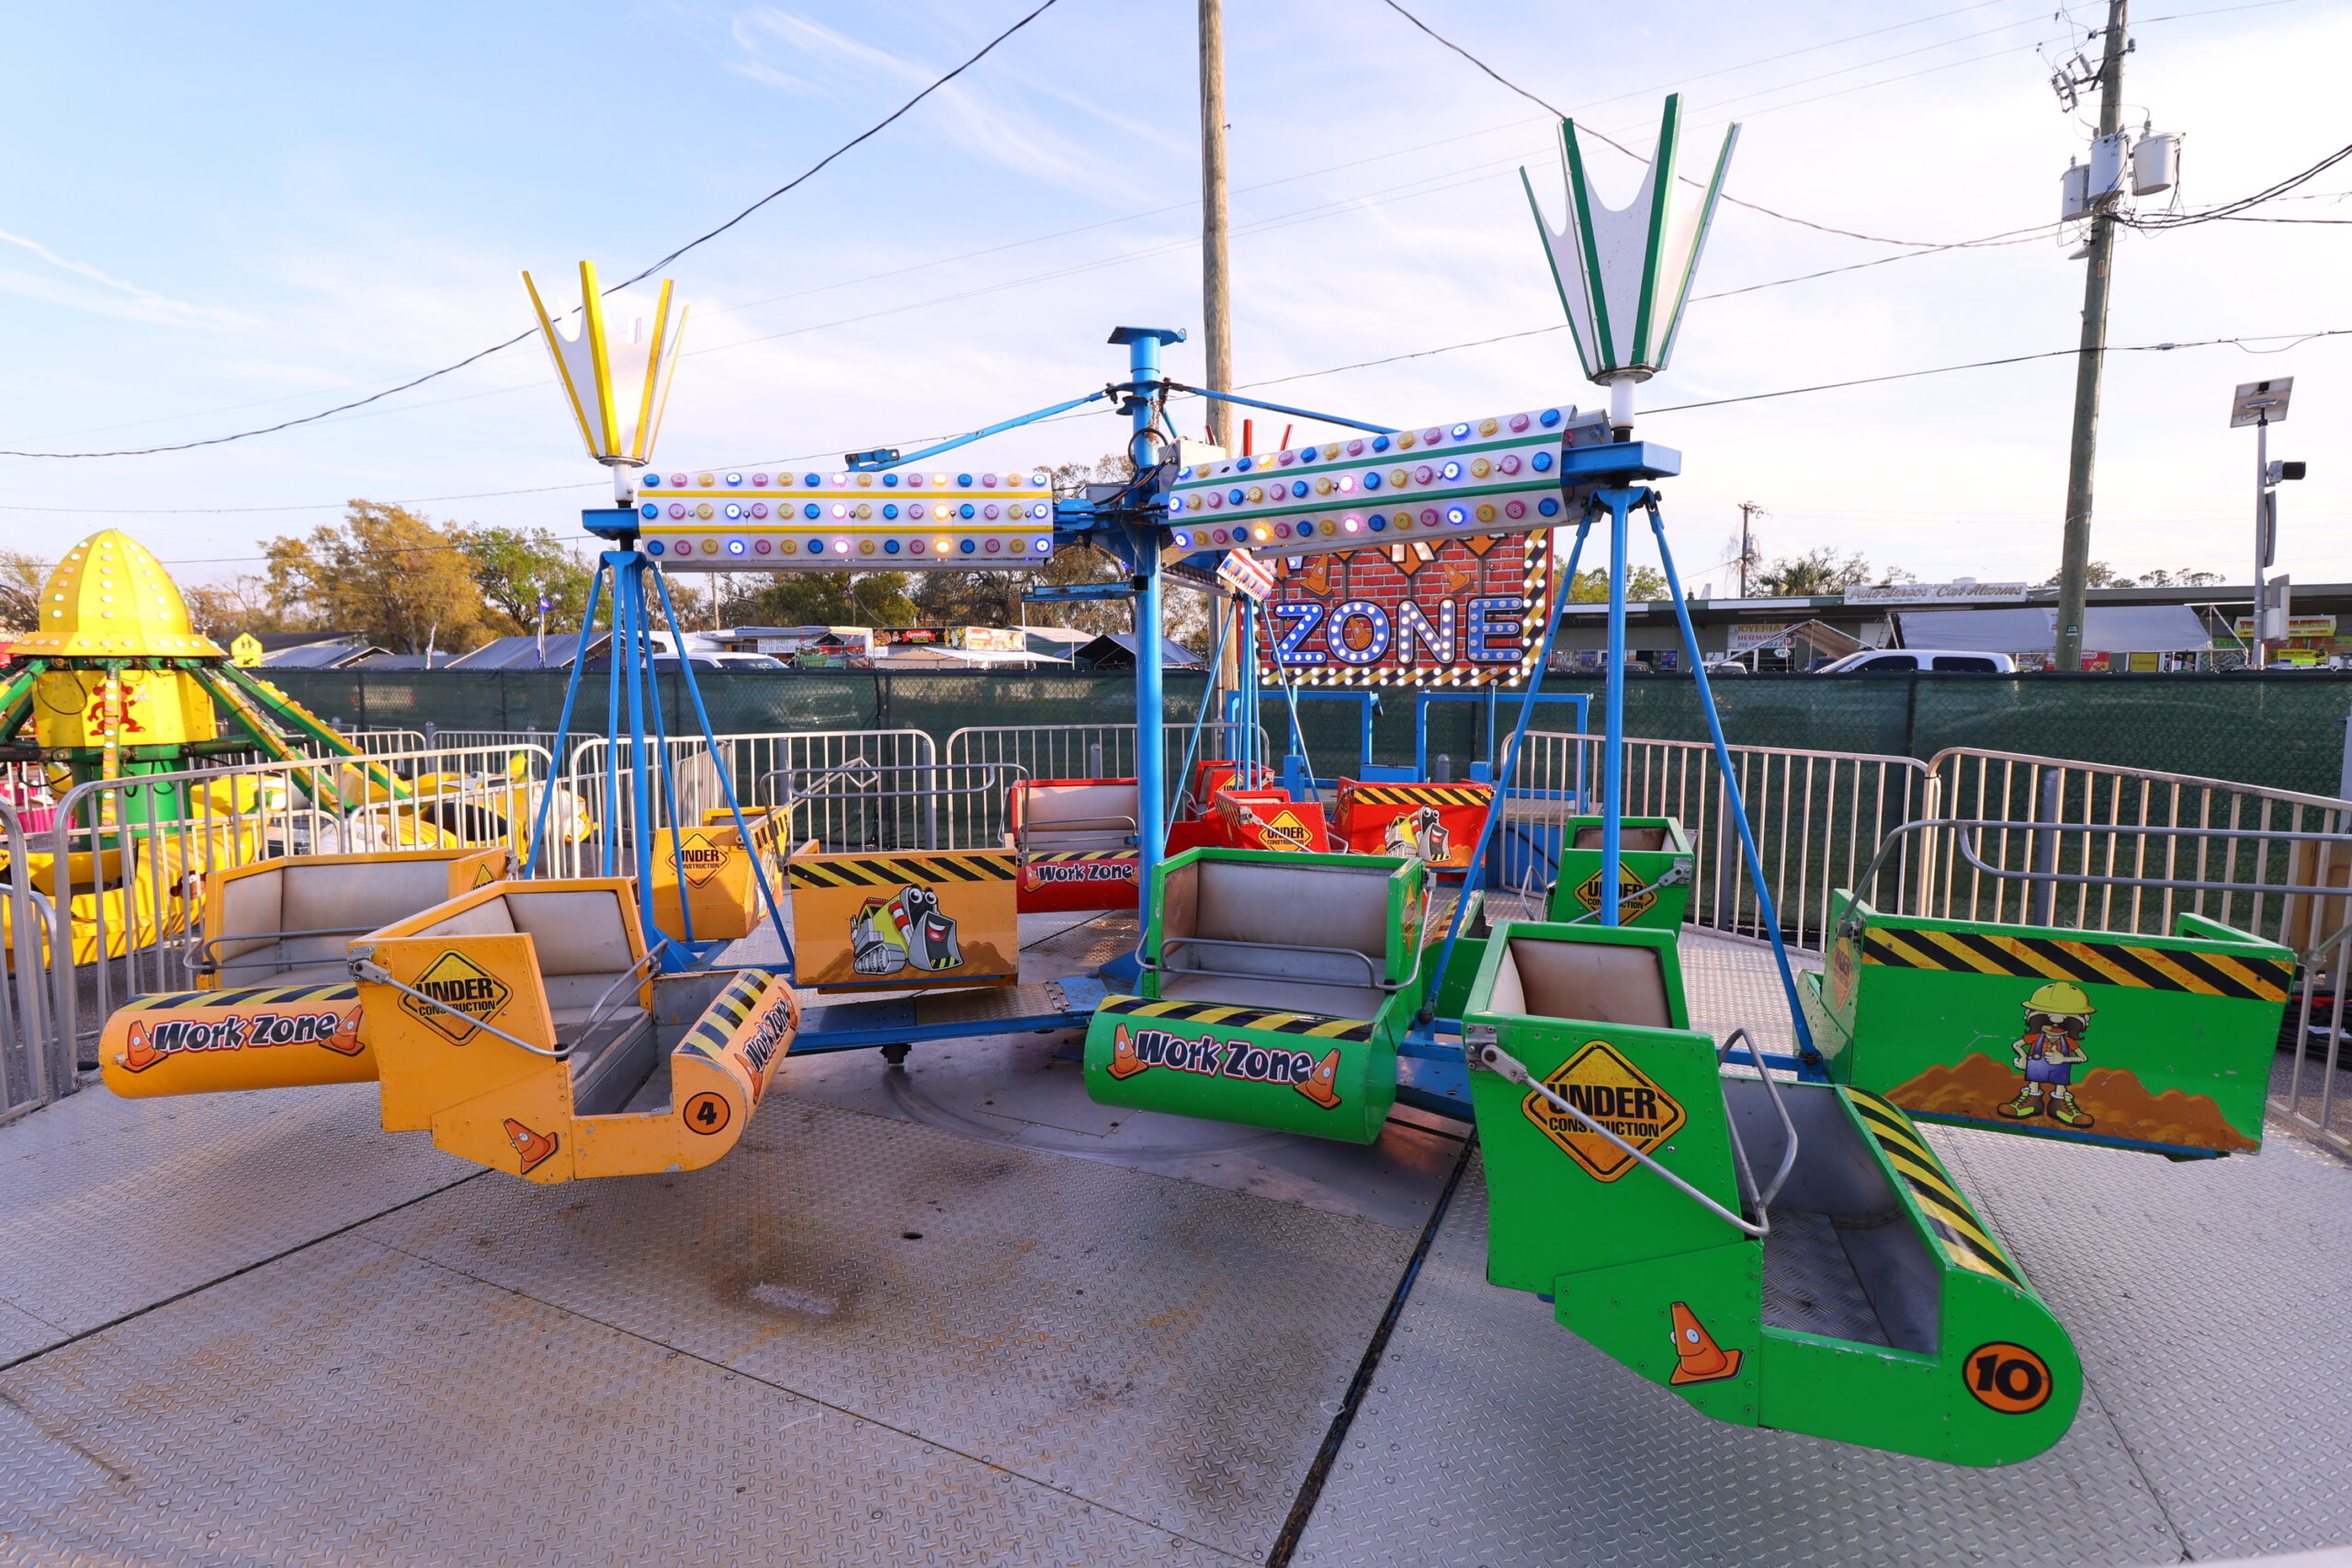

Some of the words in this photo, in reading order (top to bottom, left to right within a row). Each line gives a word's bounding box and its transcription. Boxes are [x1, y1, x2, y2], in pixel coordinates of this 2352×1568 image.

[1936, 585, 1964, 597] Car
[1966, 584, 2022, 596] Alarms
[1273, 598, 1523, 665] ZONE
[1735, 625, 1781, 633] JOYERIA
[1037, 863, 1086, 882] Work
[1088, 863, 1133, 881] Zone
[154, 1016, 247, 1053] Work
[247, 1012, 337, 1045] Zone
[745, 1023, 775, 1071] Work
[763, 998, 790, 1041] Zone
[1136, 1030, 1223, 1076] Work
[1224, 1042, 1312, 1084] Zone
[696, 1100, 718, 1126] 4
[1976, 1354, 2042, 1401] 10
